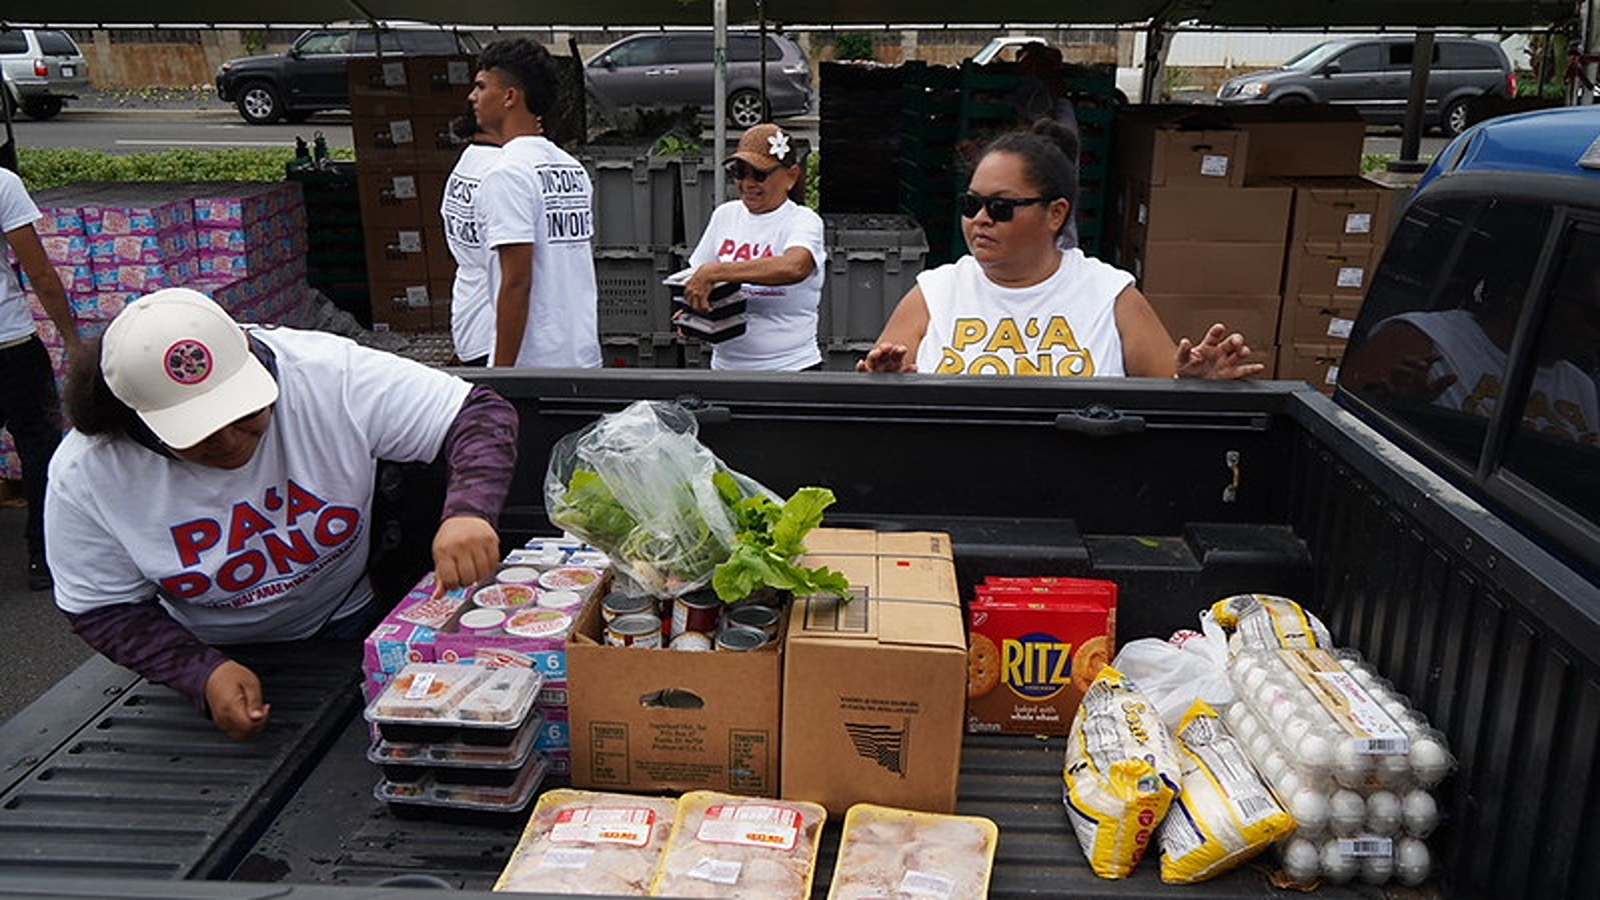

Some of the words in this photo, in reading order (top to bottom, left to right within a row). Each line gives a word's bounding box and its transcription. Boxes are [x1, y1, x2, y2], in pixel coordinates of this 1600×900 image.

[935, 347, 1096, 377] PONO
[160, 505, 360, 598] PONO
[546, 654, 560, 670] 6
[1000, 639, 1072, 686] RITZ
[1011, 712, 1034, 720] whole
[1035, 712, 1060, 721] wheat
[1014, 704, 1038, 713] baked
[1039, 704, 1056, 713] with
[548, 725, 561, 739] 6
